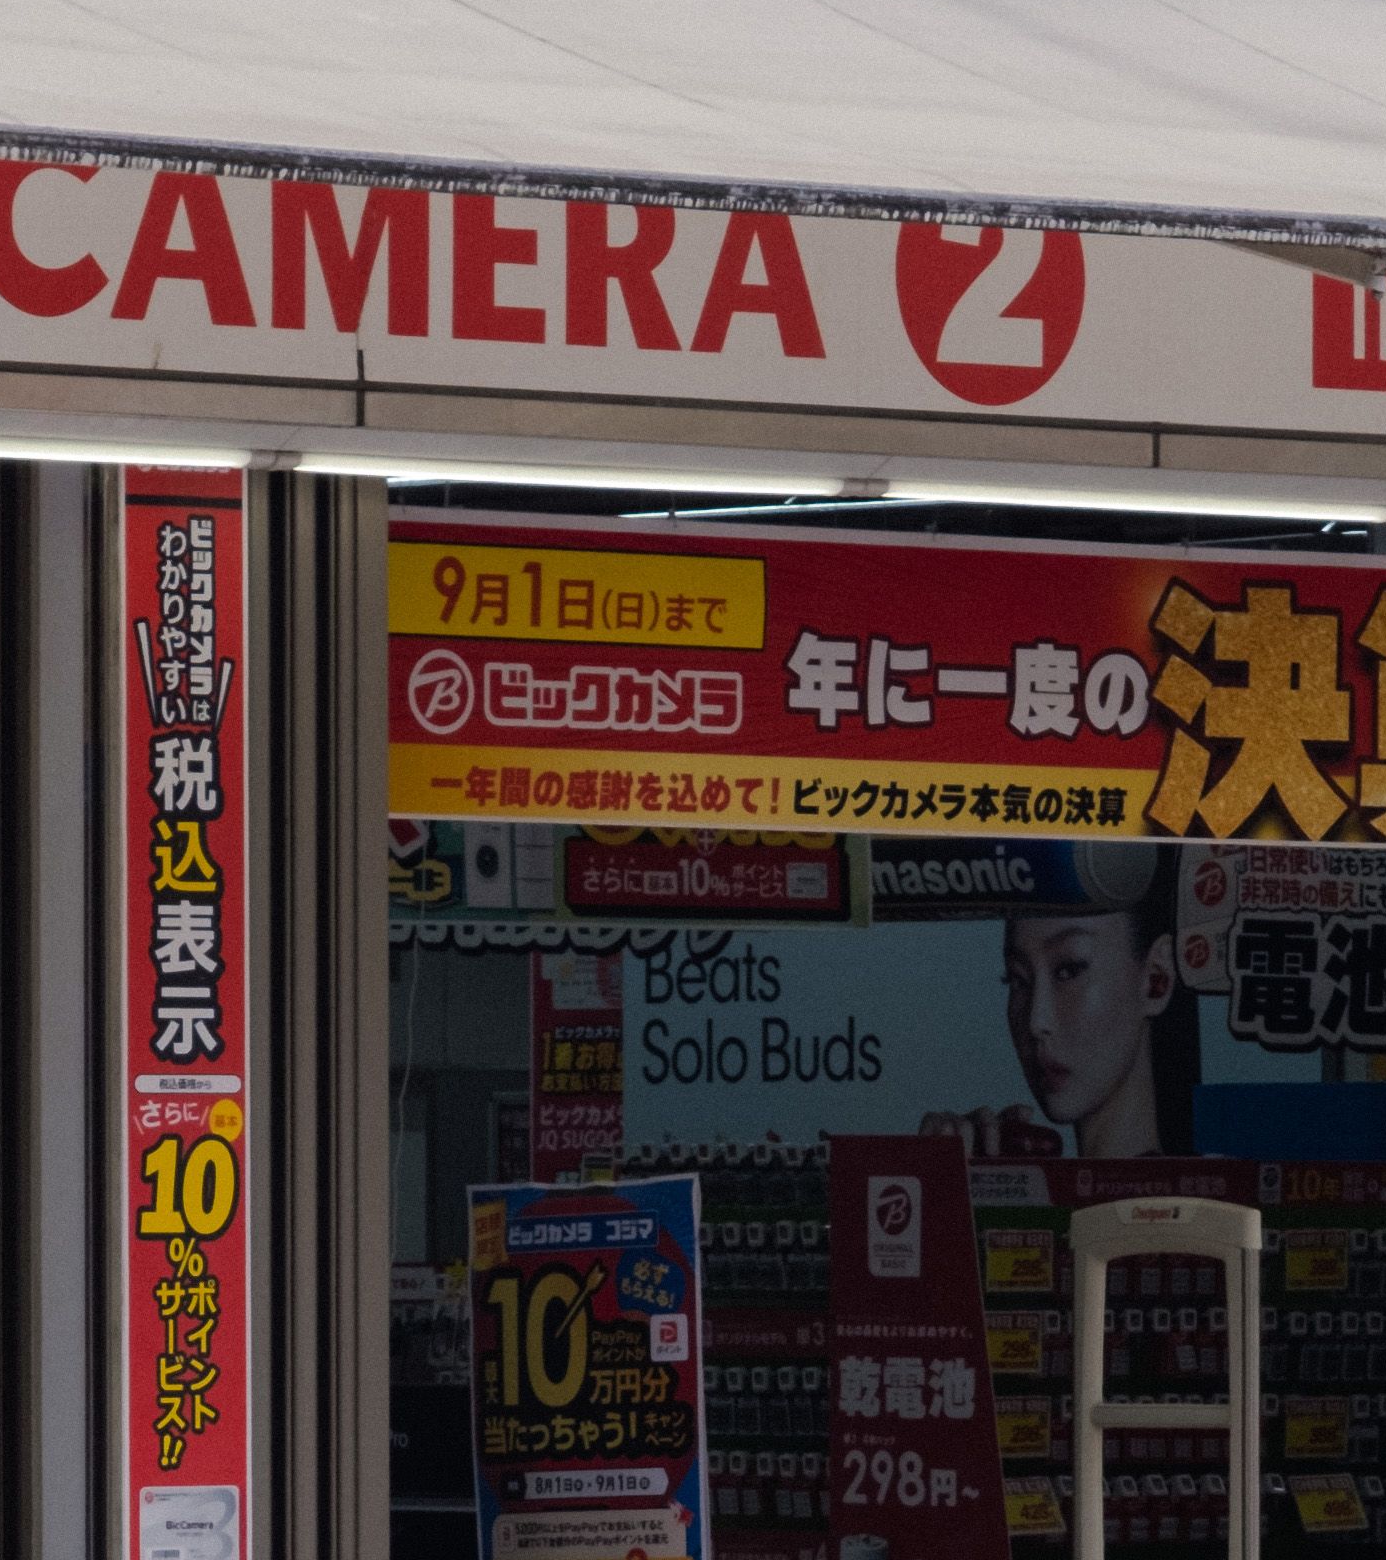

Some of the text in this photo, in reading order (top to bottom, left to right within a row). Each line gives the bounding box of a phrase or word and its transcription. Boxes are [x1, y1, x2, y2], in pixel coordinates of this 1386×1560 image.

[158, 524, 188, 725] わかりやすい
[189, 518, 214, 723] ビックカメラは
[432, 555, 729, 634] 9月1日(日)まで
[483, 659, 744, 735] ビックカメラ
[787, 630, 1152, 739] 年に一度の
[430, 766, 1128, 826] 一年間の感謝を込めて! ビックカメラ本気の決算
[154, 736, 217, 1056] 税込表示
[644, 943, 781, 1005] Beats
[642, 1015, 882, 1085] Solo Buds
[138, 1099, 201, 1130] さらに
[187, 1280, 219, 1431] ポイント
[589, 1366, 671, 1405] 万円分
[838, 1354, 977, 1420] 乾電池
[483, 1411, 637, 1455] 当たっちゃう!
